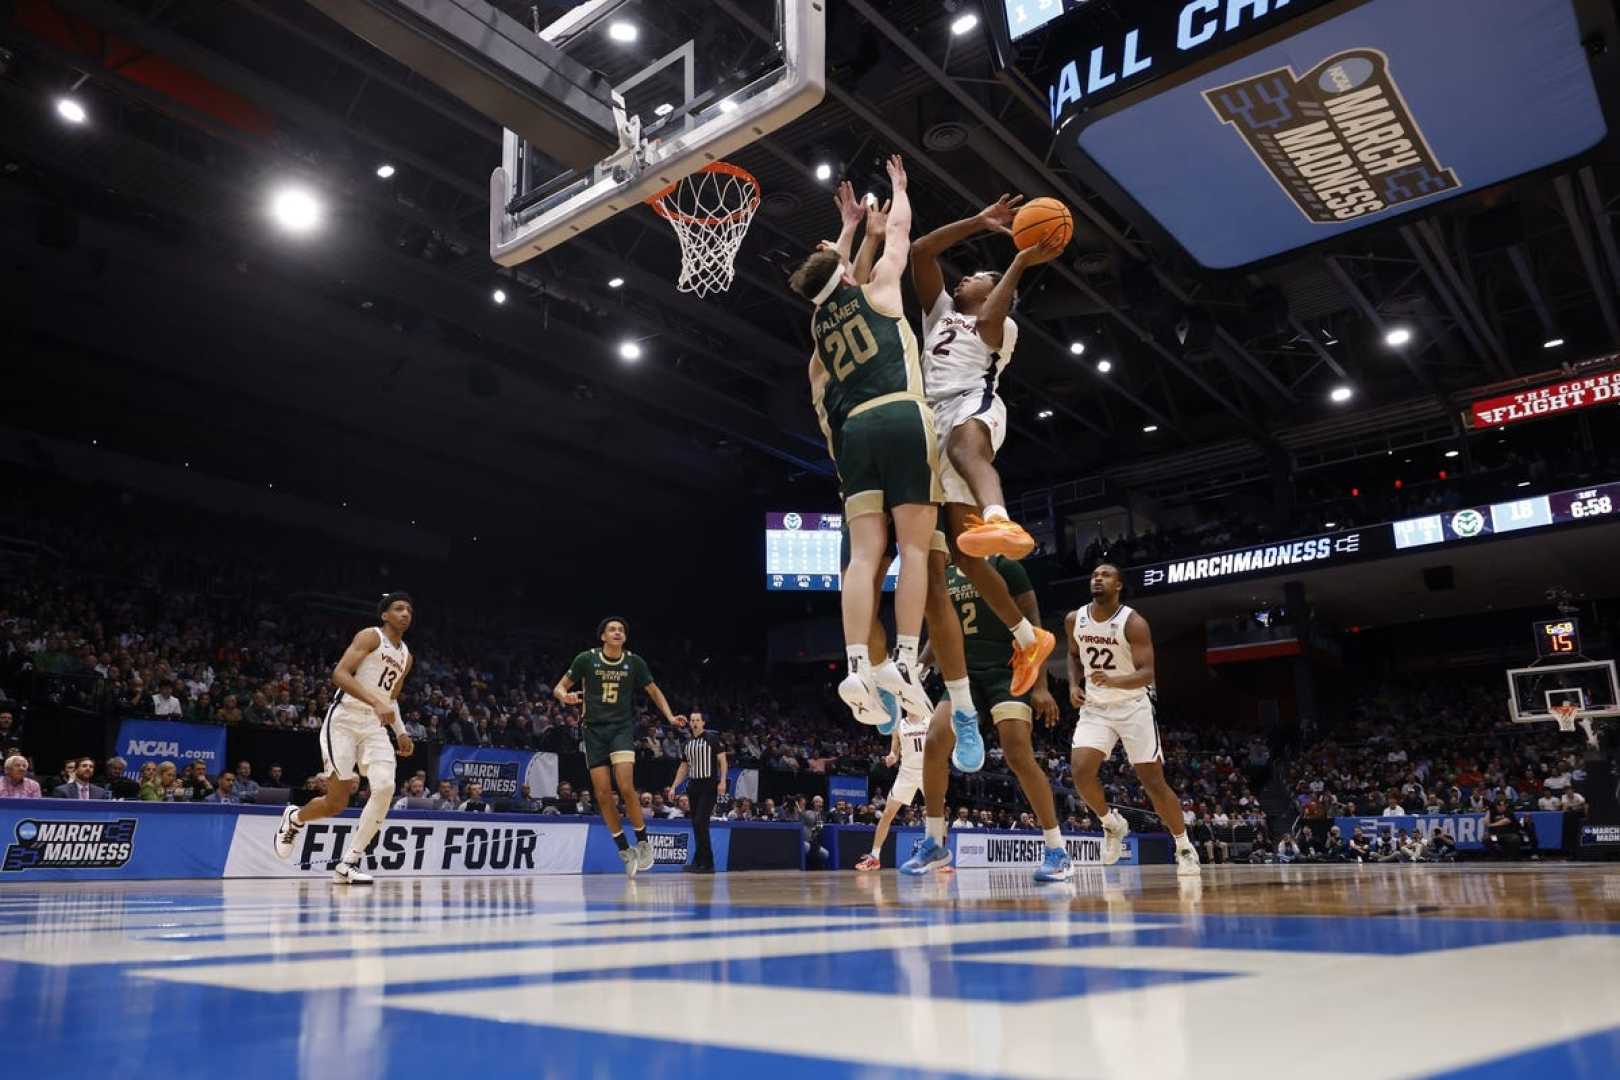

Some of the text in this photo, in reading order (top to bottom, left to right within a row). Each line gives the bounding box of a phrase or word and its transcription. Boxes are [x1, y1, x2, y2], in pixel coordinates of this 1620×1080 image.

[1050, 0, 1291, 128] ALL CH
[1323, 84, 1422, 175] MARCH
[1273, 119, 1385, 220] MADNESS
[815, 298, 861, 337] PALMER
[824, 314, 879, 383] 20
[932, 329, 957, 356] 2
[1491, 389, 1586, 422] FLIGHT
[1514, 388, 1550, 403] THE
[1570, 496, 1613, 518] 6:58
[1167, 537, 1331, 584] MARCHMADNESS
[961, 602, 979, 635] 2
[1079, 634, 1120, 647] VIRGINIA
[1552, 634, 1573, 652] 15
[1086, 646, 1117, 670] 22
[377, 666, 398, 691] 13
[601, 682, 620, 704] 15
[127, 739, 215, 760] NCAA.com
[913, 737, 923, 753] 11
[463, 763, 501, 778] MARCH
[37, 823, 105, 842] MARCH
[647, 835, 675, 847] MARCH
[1416, 817, 1487, 843] MARC
[43, 842, 131, 861] MADNESS
[441, 826, 539, 870] FOUR
[987, 839, 1045, 863] UNIVERSIT
[1066, 840, 1101, 861] DAYTON
